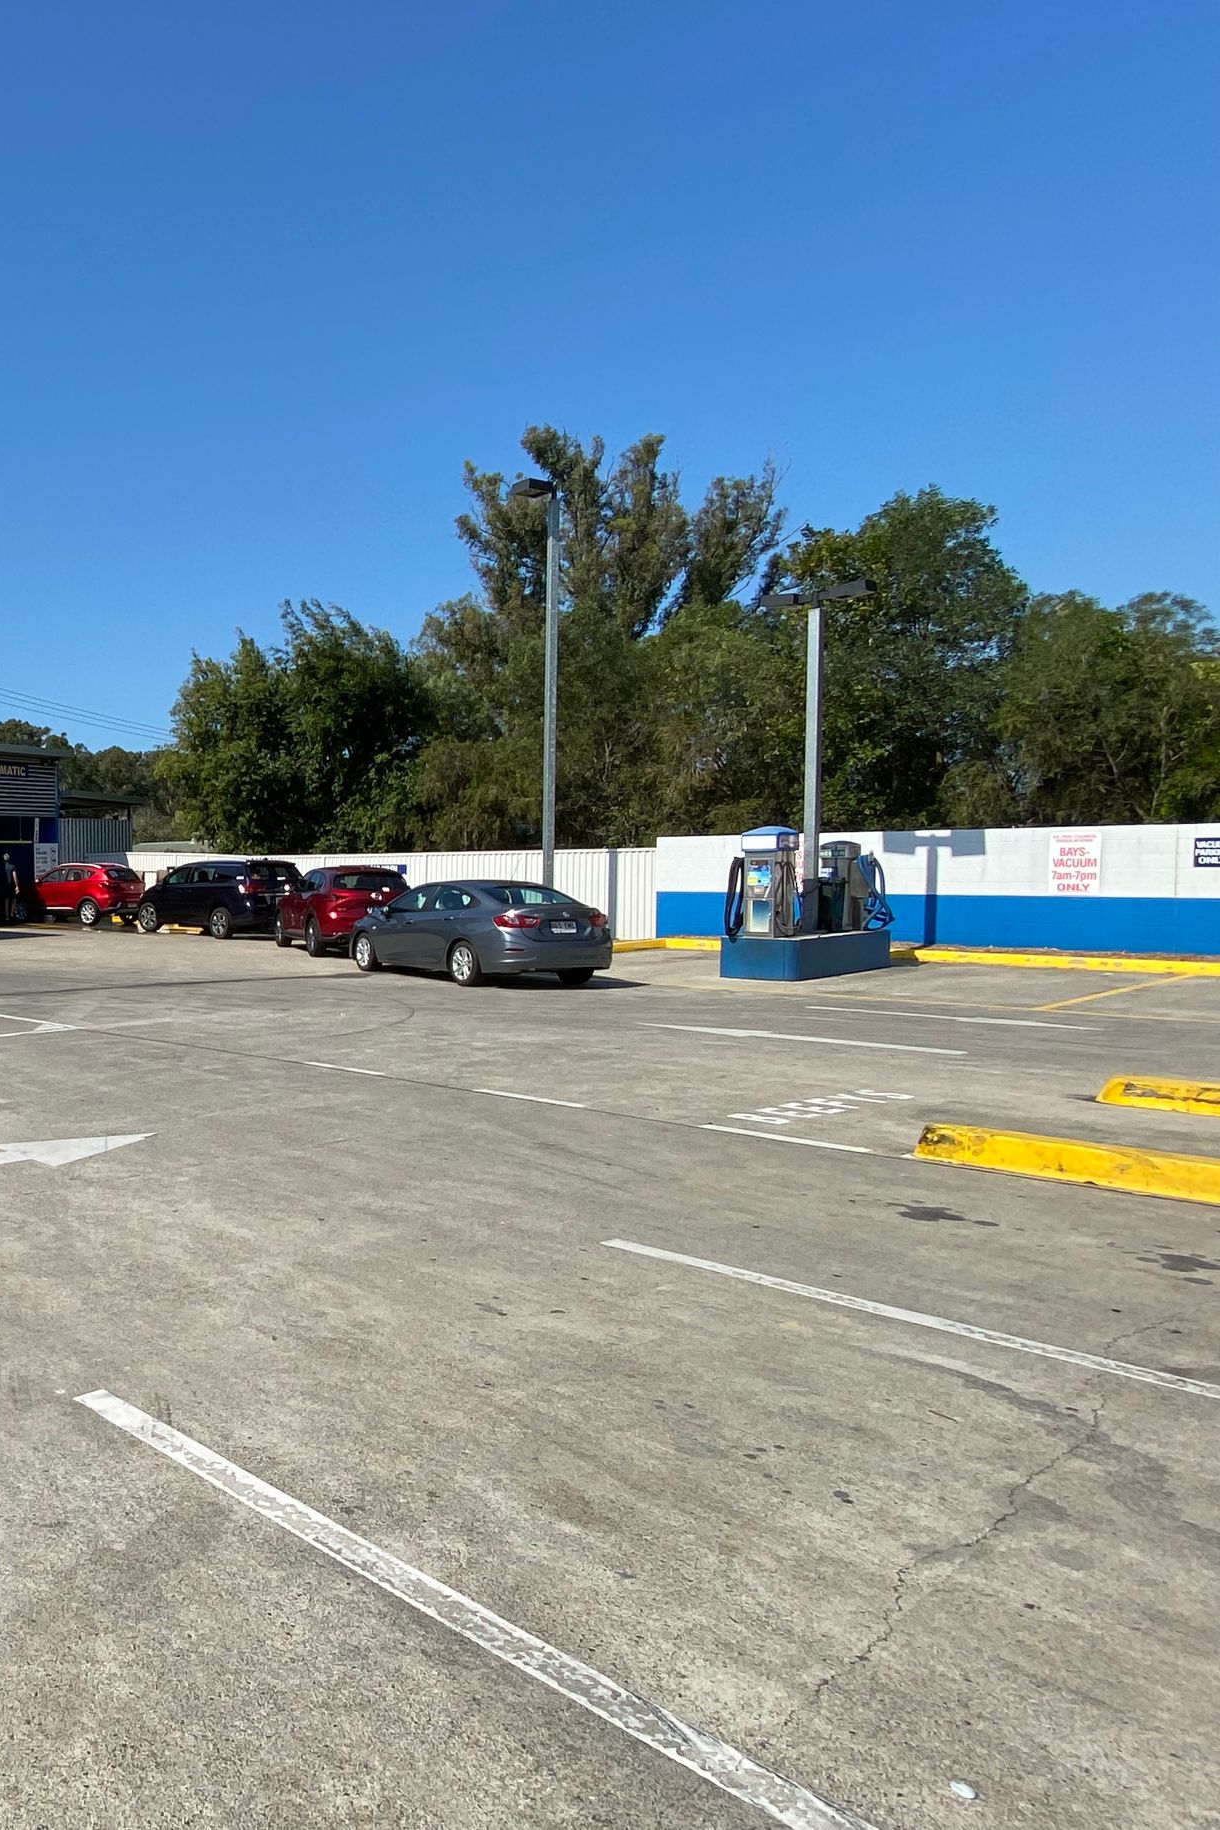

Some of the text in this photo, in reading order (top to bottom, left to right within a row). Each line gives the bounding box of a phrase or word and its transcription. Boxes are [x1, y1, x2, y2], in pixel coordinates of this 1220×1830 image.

[1059, 847, 1090, 857] BAYS-
[1052, 858, 1097, 868] VACUUM
[1051, 870, 1097, 882] 7am-7pm
[1056, 883, 1090, 892] ONLY
